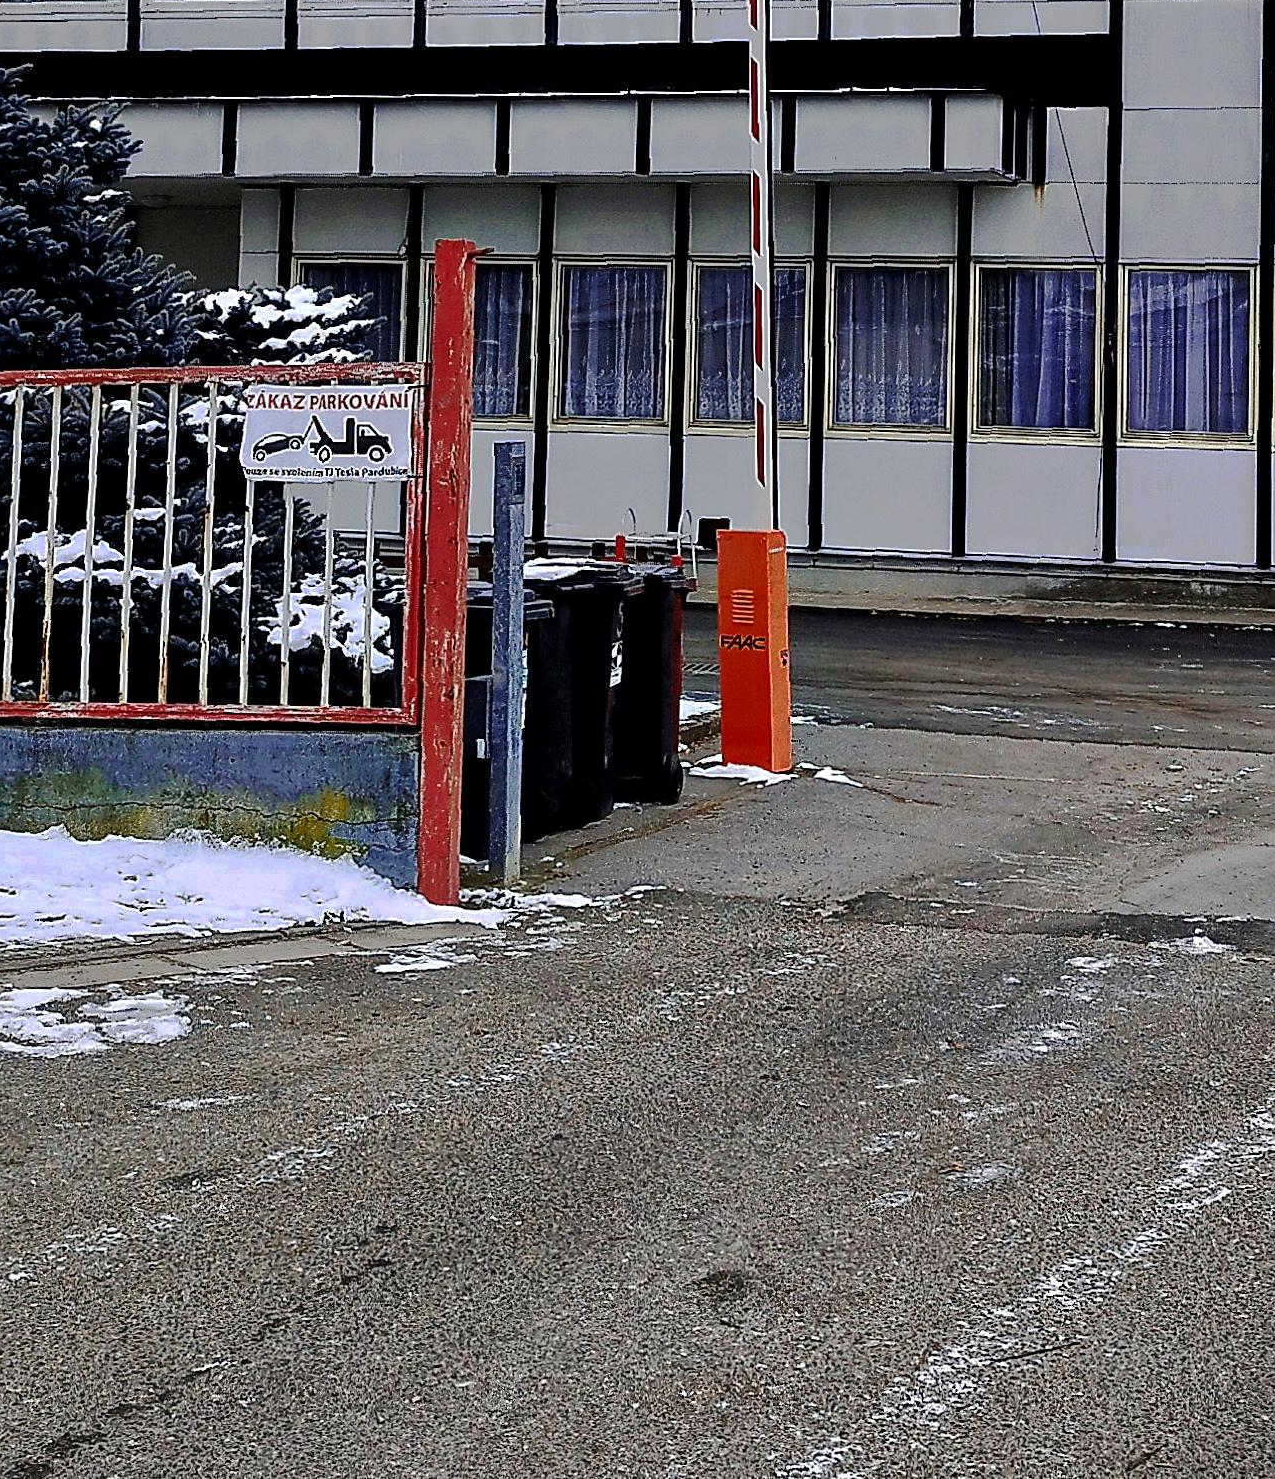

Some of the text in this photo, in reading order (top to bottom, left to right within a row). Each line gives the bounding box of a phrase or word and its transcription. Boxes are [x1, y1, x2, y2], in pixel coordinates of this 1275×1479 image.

[247, 389, 409, 410] ZÁKAZ PARKOVÁNÍ
[720, 634, 766, 651] FAAC
